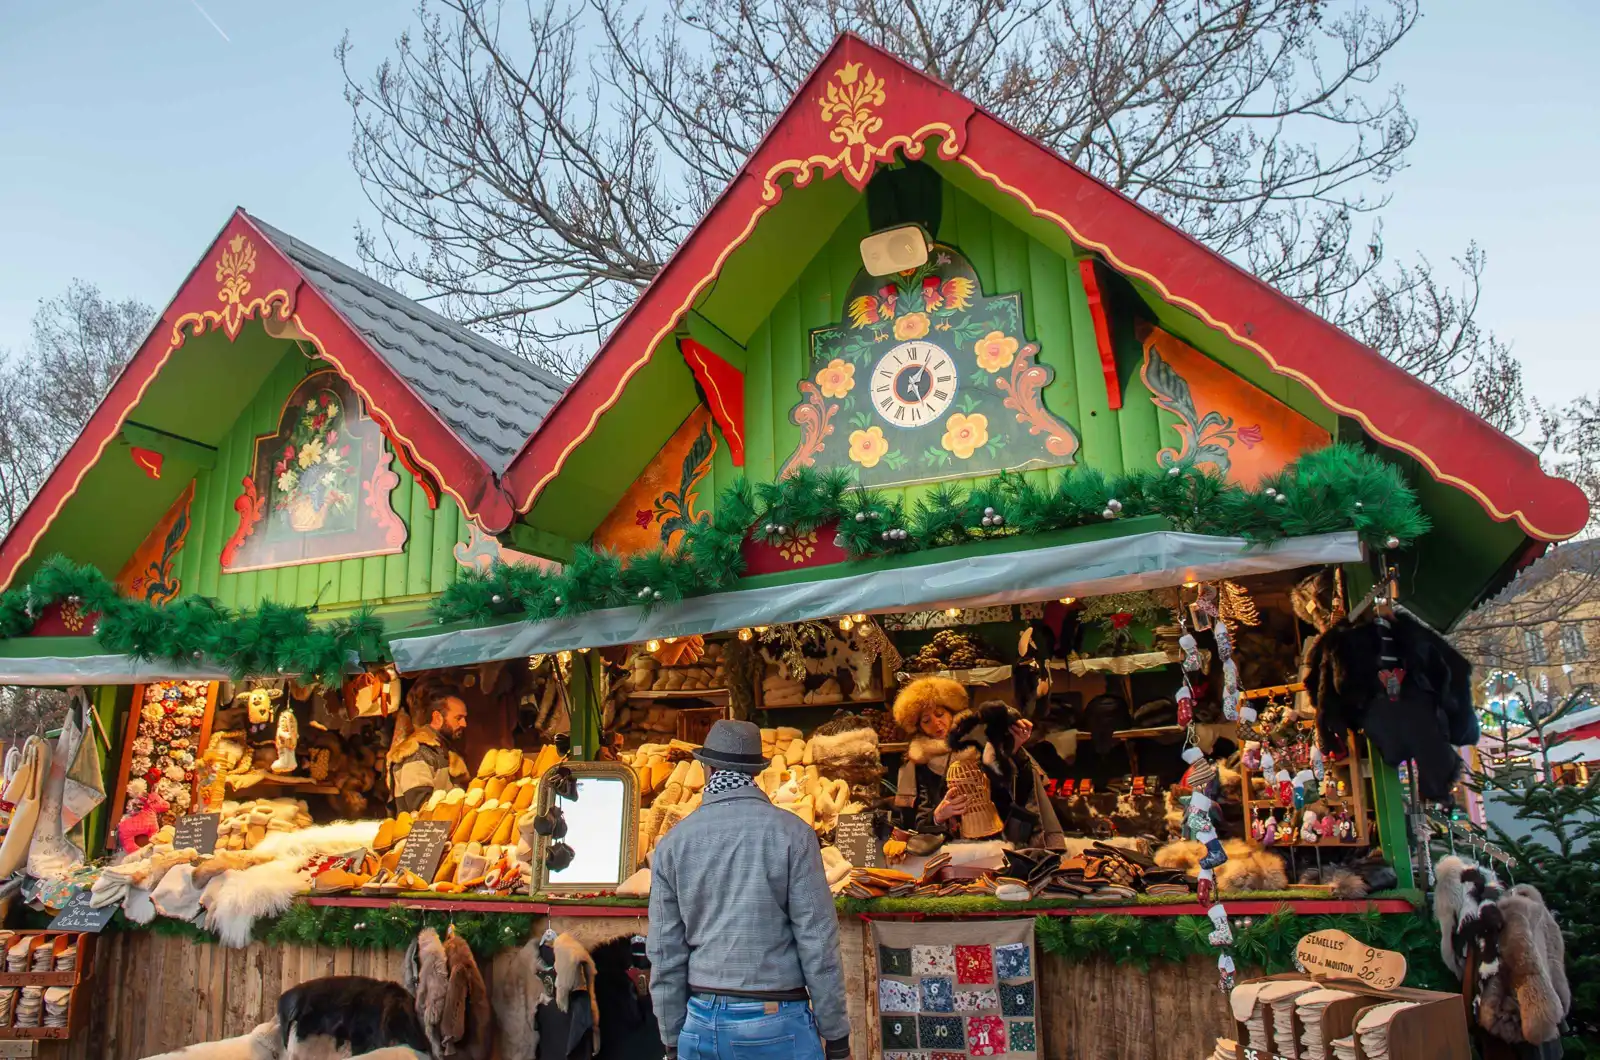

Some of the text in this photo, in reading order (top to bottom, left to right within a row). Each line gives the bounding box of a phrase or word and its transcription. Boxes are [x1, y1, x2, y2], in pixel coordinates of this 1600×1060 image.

[1306, 935, 1344, 951] SEMELLES
[893, 955, 899, 966] 1
[928, 955, 937, 966] 2
[1010, 956, 1017, 966] 4
[1298, 951, 1317, 964] PEAU
[1325, 959, 1355, 973] MOUTON
[931, 983, 939, 994] 6
[1384, 977, 1395, 989] 3
[1016, 994, 1025, 1005] 8
[894, 1023, 902, 1035] 9
[935, 1025, 948, 1037] 10
[1243, 1049, 1258, 1060] 36
